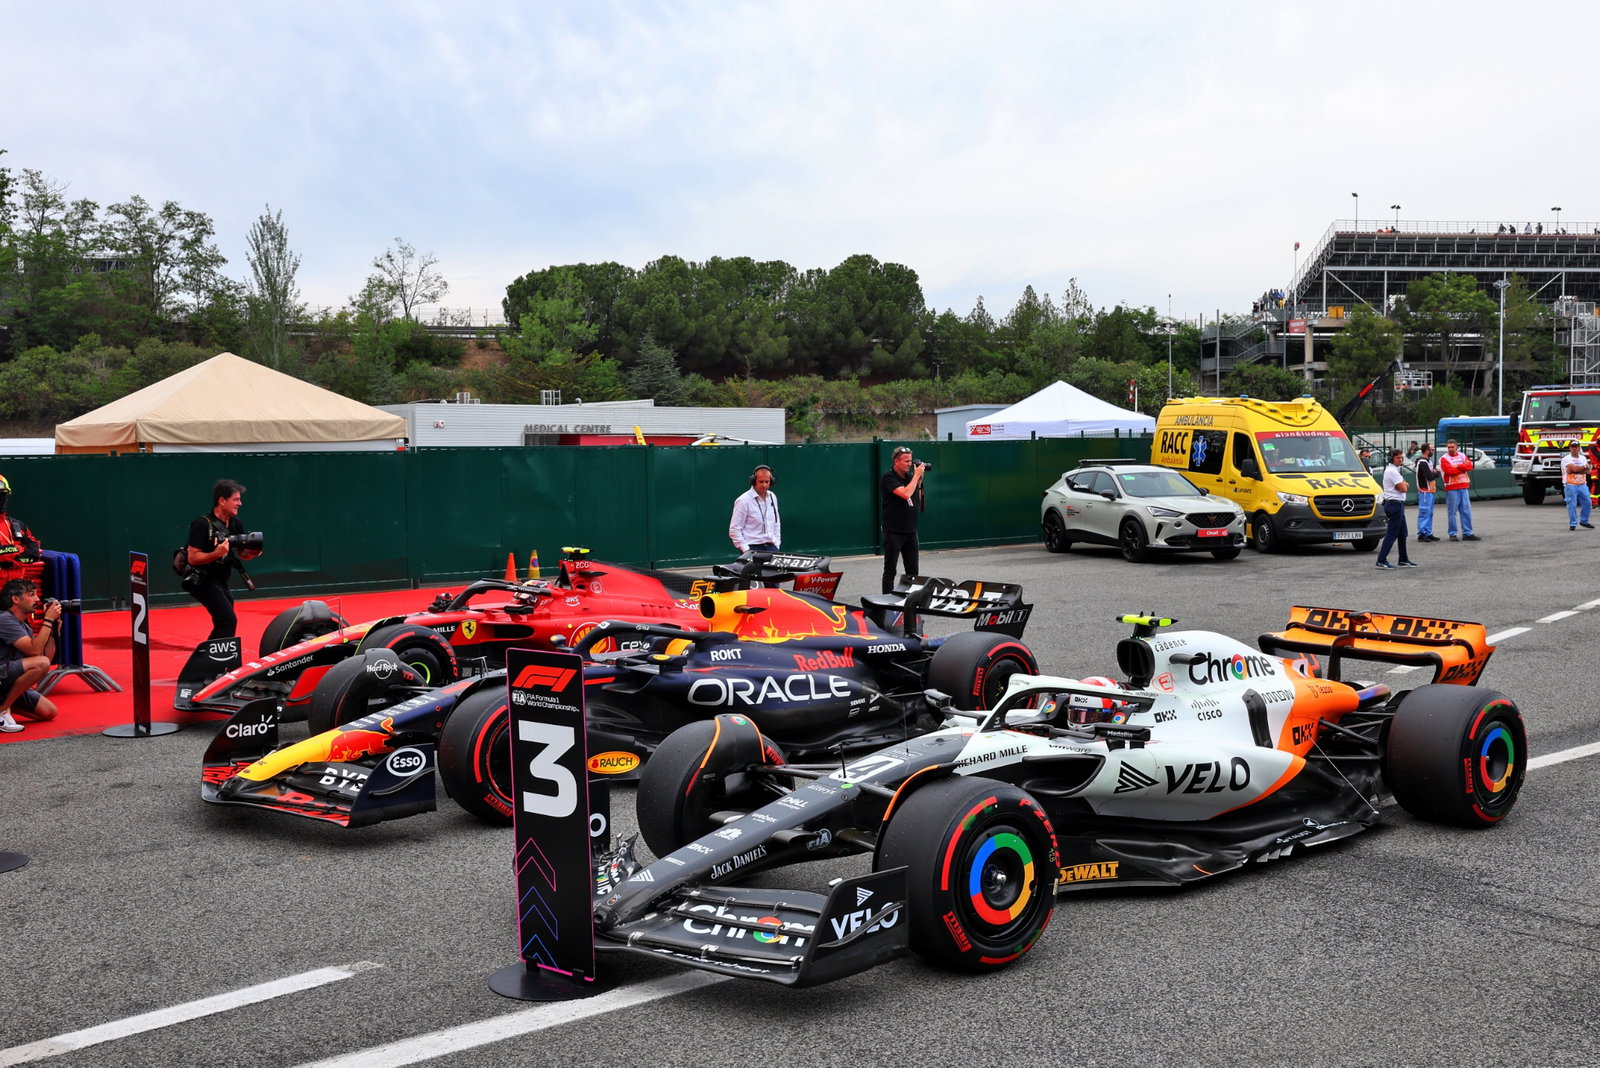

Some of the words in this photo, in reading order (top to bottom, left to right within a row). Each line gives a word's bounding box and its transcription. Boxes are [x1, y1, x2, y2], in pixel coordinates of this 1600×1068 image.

[524, 424, 570, 434] MEDICAL
[573, 424, 612, 433] CENTRE
[1161, 431, 1189, 455] RACC
[1306, 478, 1370, 490] RACC
[132, 592, 147, 645] 2
[977, 610, 1013, 627] Mobil
[209, 642, 237, 654] aws
[710, 648, 742, 662] ROKT
[867, 643, 907, 654] HONDA
[275, 655, 314, 674] Santander
[972, 666, 985, 697] PIRELLI
[687, 674, 852, 706] ORACLE
[527, 700, 542, 708] World
[541, 702, 575, 712] Championship
[535, 695, 556, 703] Formula
[226, 722, 268, 738] Claro
[1000, 745, 1028, 759] MILLE
[518, 720, 578, 818] 3
[600, 757, 633, 767] RAUCH
[1164, 756, 1251, 795] VELO
[711, 864, 733, 879] JACK
[733, 844, 767, 869] DANIEL'S
[830, 901, 899, 940] VELO
